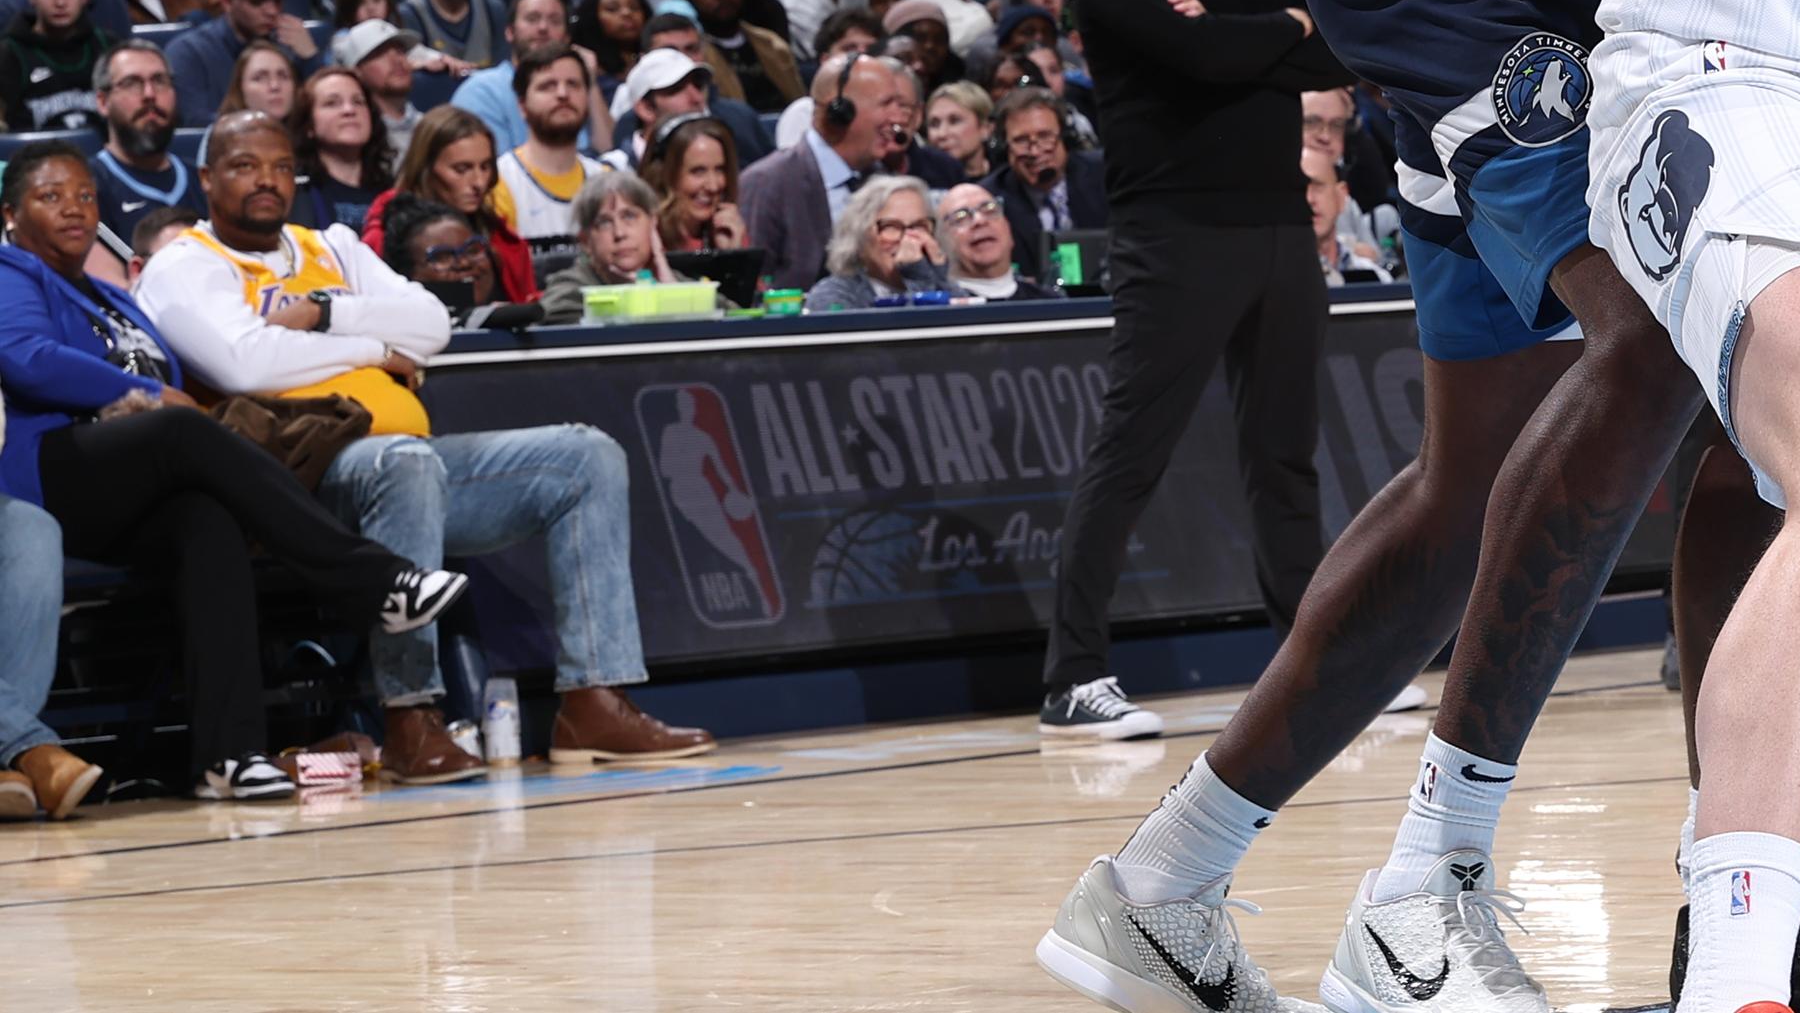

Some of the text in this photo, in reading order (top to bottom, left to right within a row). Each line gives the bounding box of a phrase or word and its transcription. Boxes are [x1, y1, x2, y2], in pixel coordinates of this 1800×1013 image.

[1495, 36, 1588, 126] MINNESOTA TIMBER
[750, 378, 862, 498] ALL
[851, 370, 1008, 492] STAR
[917, 515, 988, 574] Los
[699, 572, 751, 613] NBA
